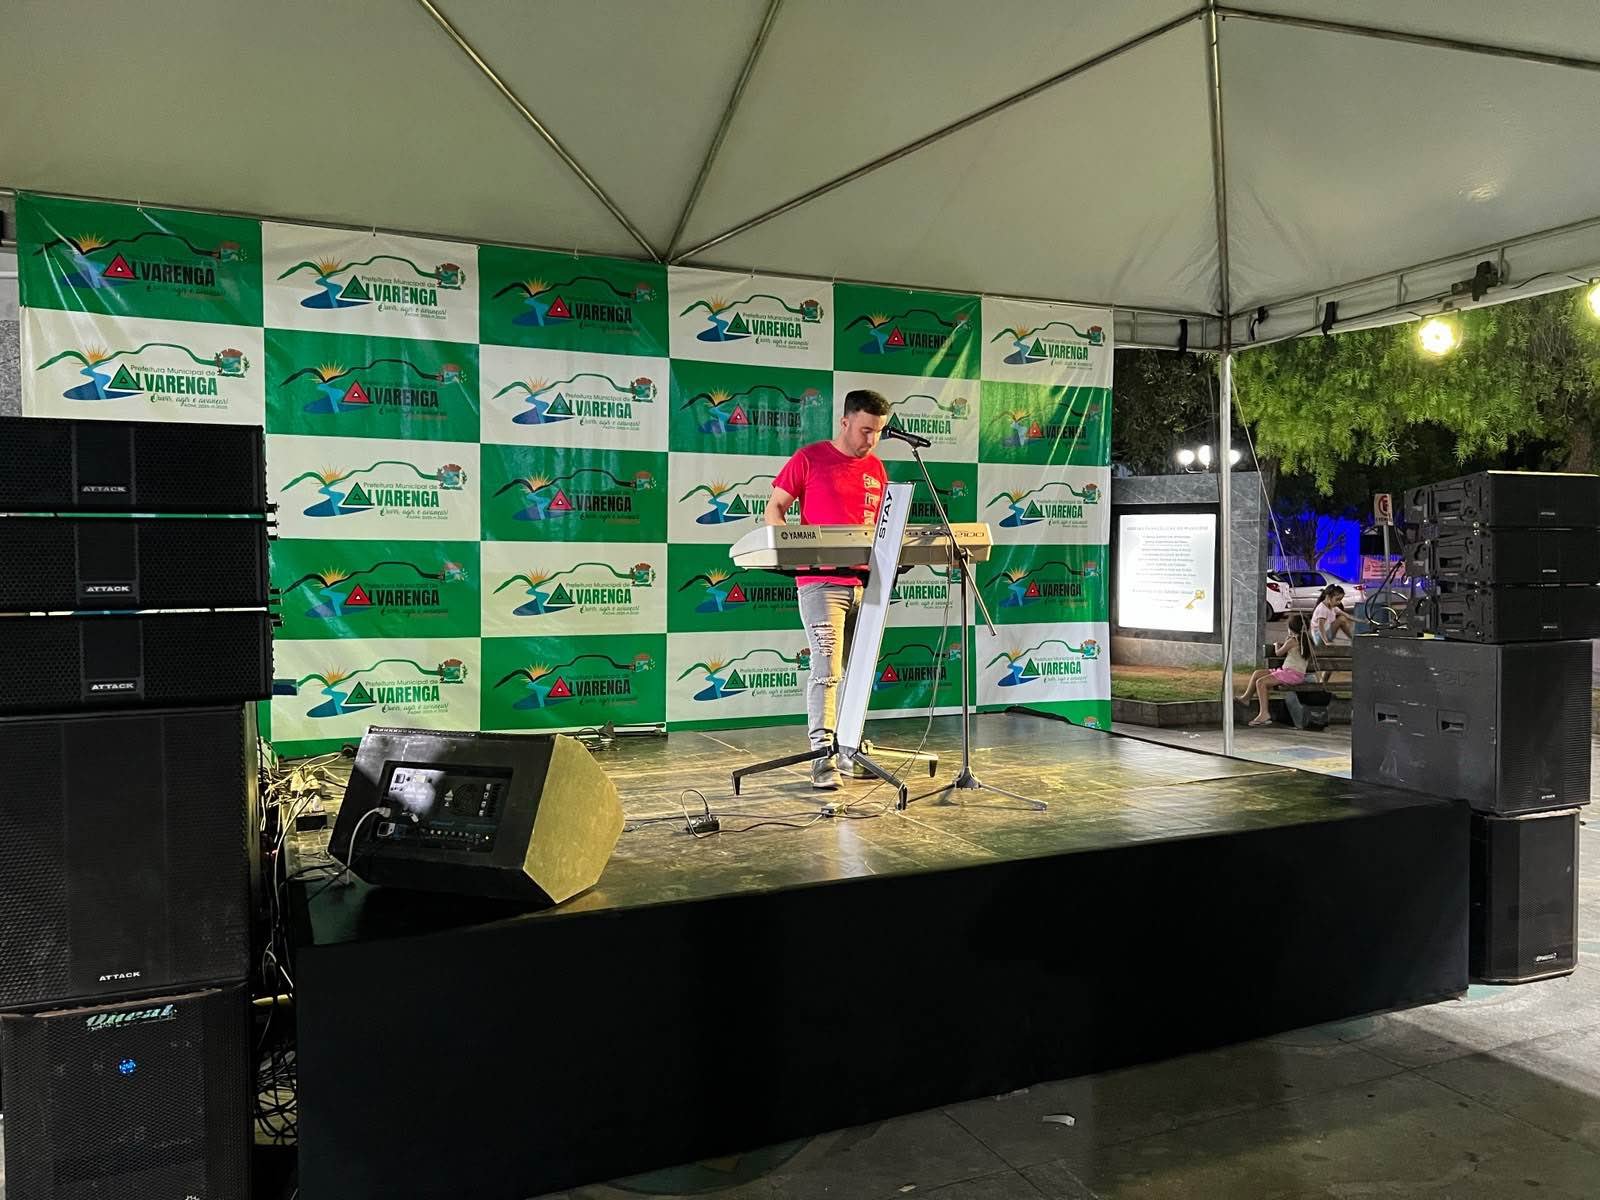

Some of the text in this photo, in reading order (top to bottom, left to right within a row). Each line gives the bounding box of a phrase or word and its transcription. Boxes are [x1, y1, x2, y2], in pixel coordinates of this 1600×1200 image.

[878, 490, 893, 539] STAY
[788, 531, 817, 540] YAMAHA
[91, 682, 134, 691] ATTACK
[99, 971, 141, 981] ATTACK
